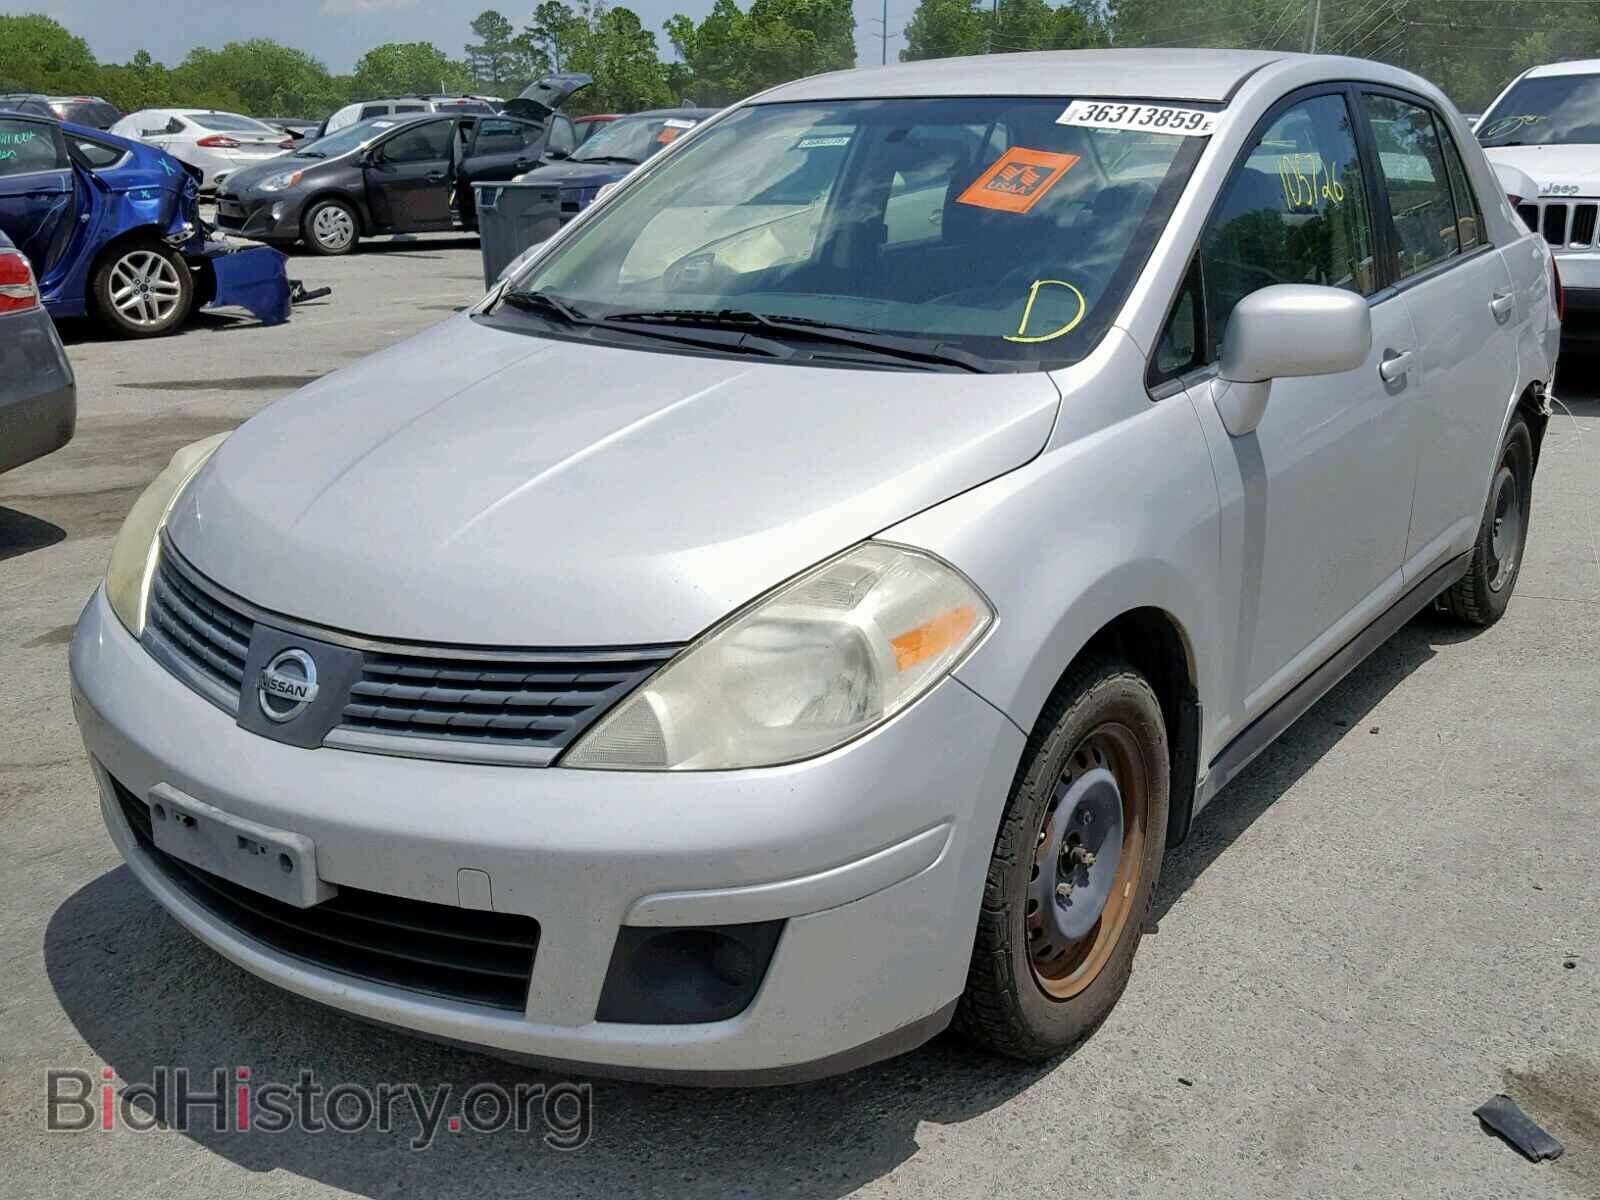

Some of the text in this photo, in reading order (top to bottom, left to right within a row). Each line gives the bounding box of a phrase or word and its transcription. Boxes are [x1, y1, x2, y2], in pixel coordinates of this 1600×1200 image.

[1078, 104, 1205, 130] 36313859
[1542, 183, 1580, 196] Jeep
[1002, 280, 1086, 342] D
[261, 678, 307, 698] NISSAN
